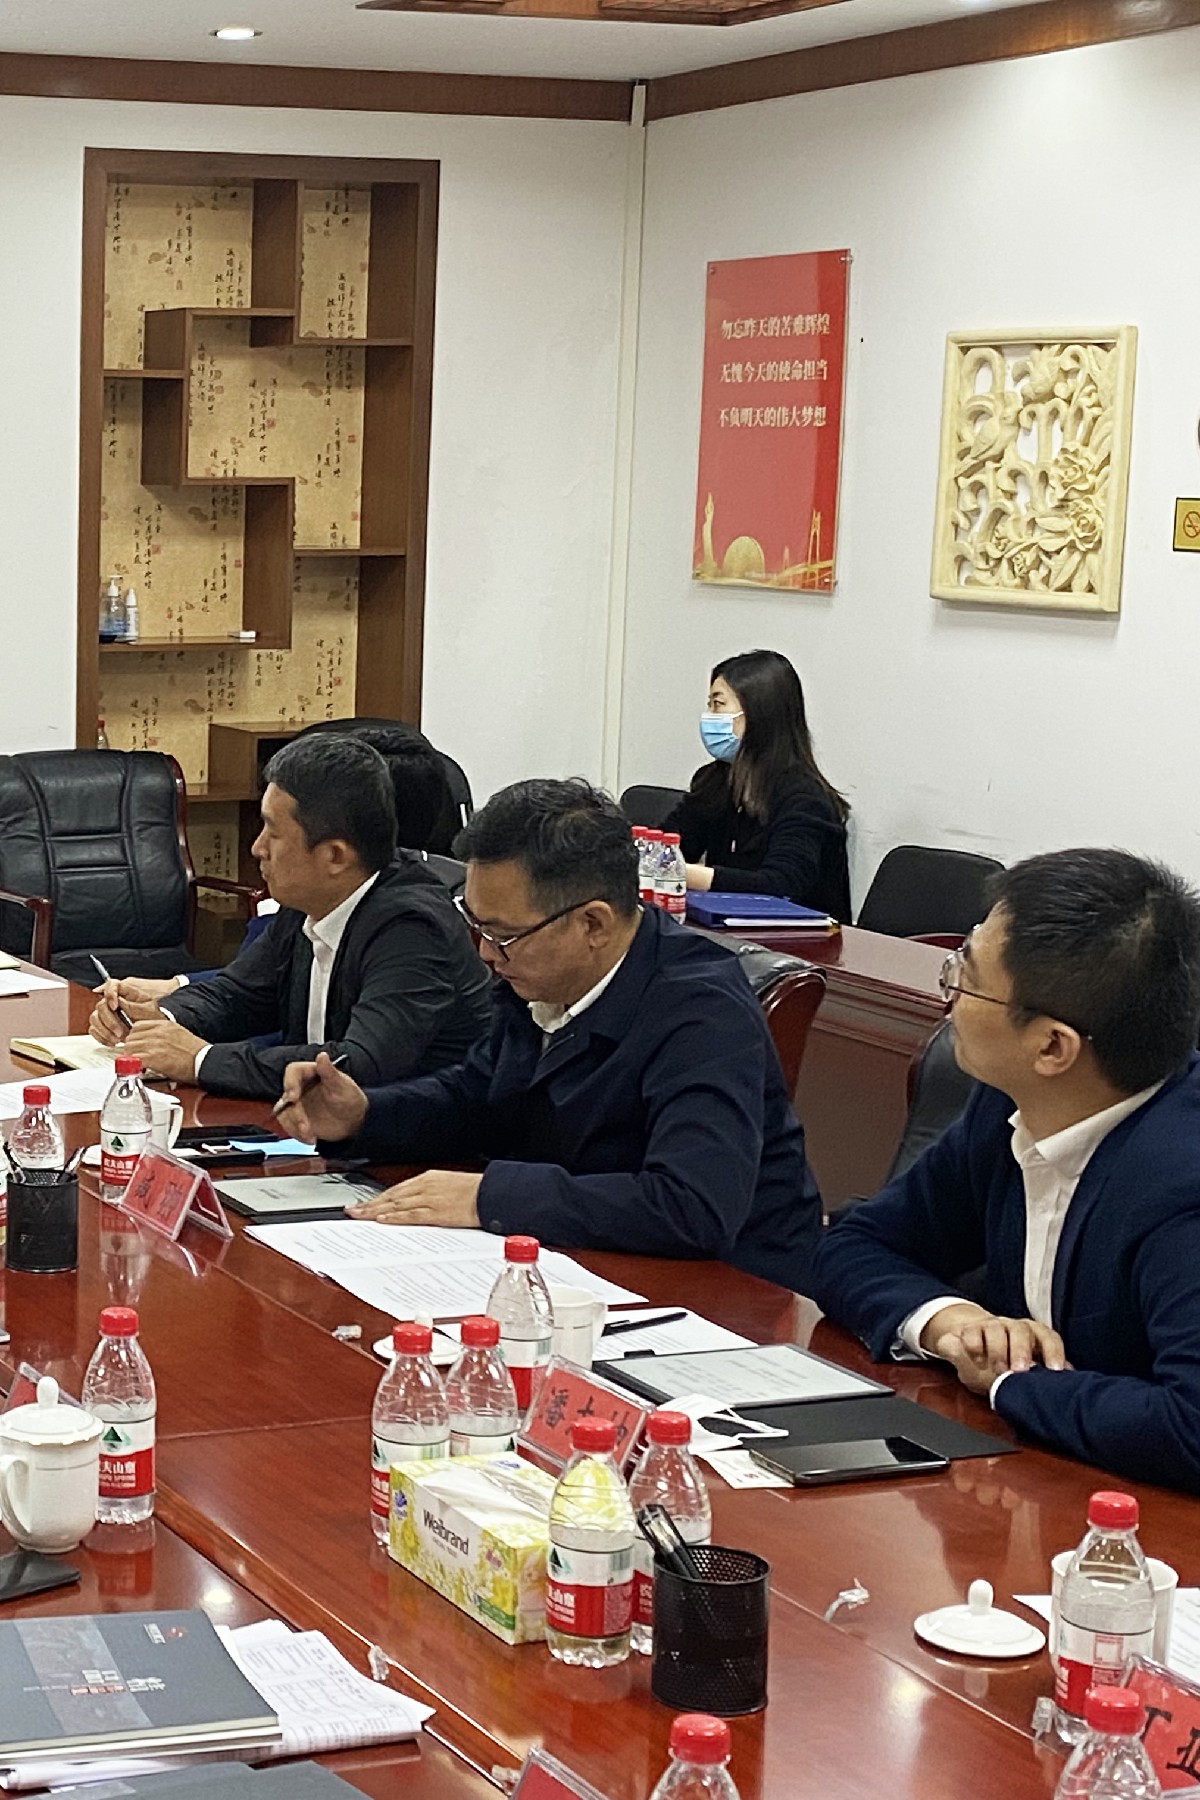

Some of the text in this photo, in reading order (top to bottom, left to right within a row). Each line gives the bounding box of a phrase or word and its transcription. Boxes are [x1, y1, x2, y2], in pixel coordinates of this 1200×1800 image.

[721, 313, 830, 340] 勿忘昨天的苦难辉煌
[720, 359, 828, 383] 无愧今天的使命担当
[719, 405, 827, 428] 不负明天的伟大梦想
[99, 1460, 136, 1474] 夫山泉
